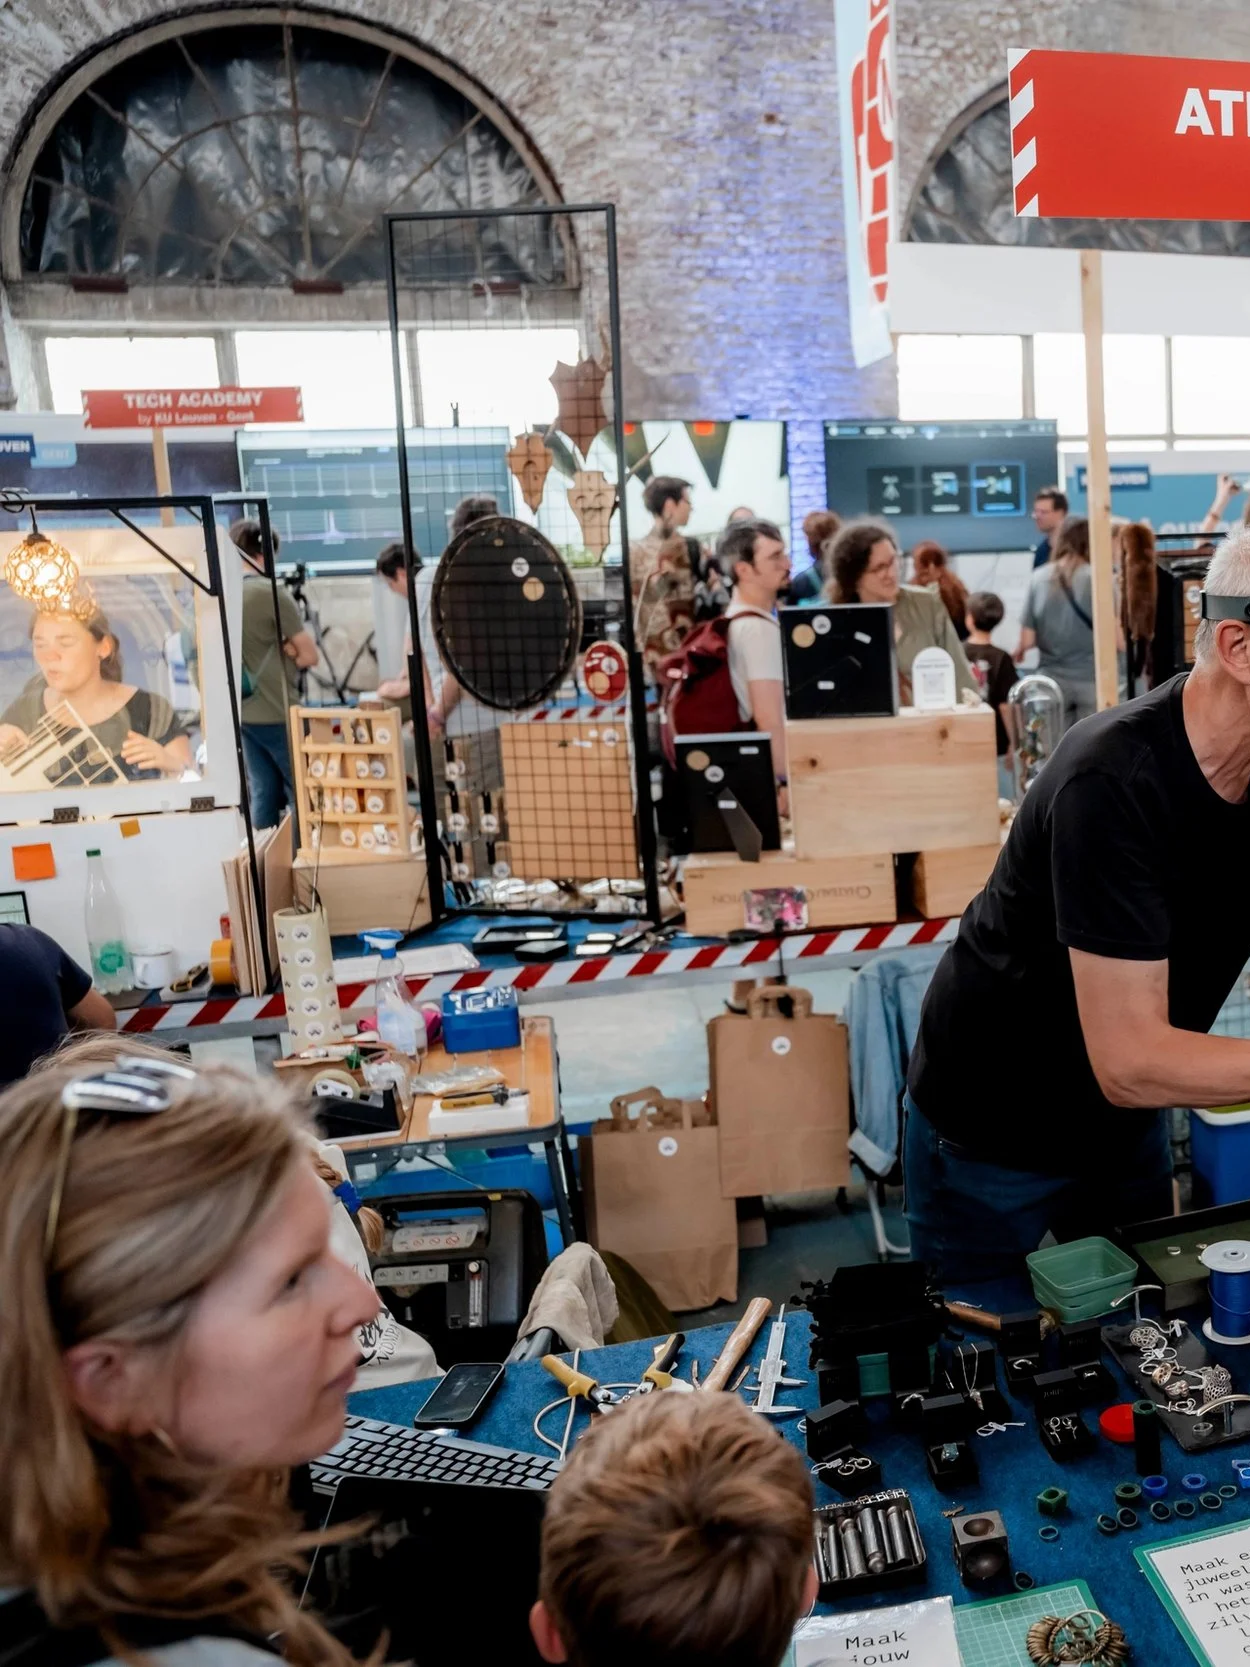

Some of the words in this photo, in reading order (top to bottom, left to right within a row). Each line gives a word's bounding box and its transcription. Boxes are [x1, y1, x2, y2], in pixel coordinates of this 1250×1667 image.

[124, 392, 173, 409] TECH
[178, 391, 263, 408] ACADEMY
[138, 412, 152, 426] by
[155, 412, 173, 424] KU
[175, 412, 217, 424] Leuven
[226, 410, 255, 423] Gent
[1180, 1556, 1229, 1575] Maak
[1186, 1590, 1210, 1604] in
[845, 1629, 907, 1650] Maak
